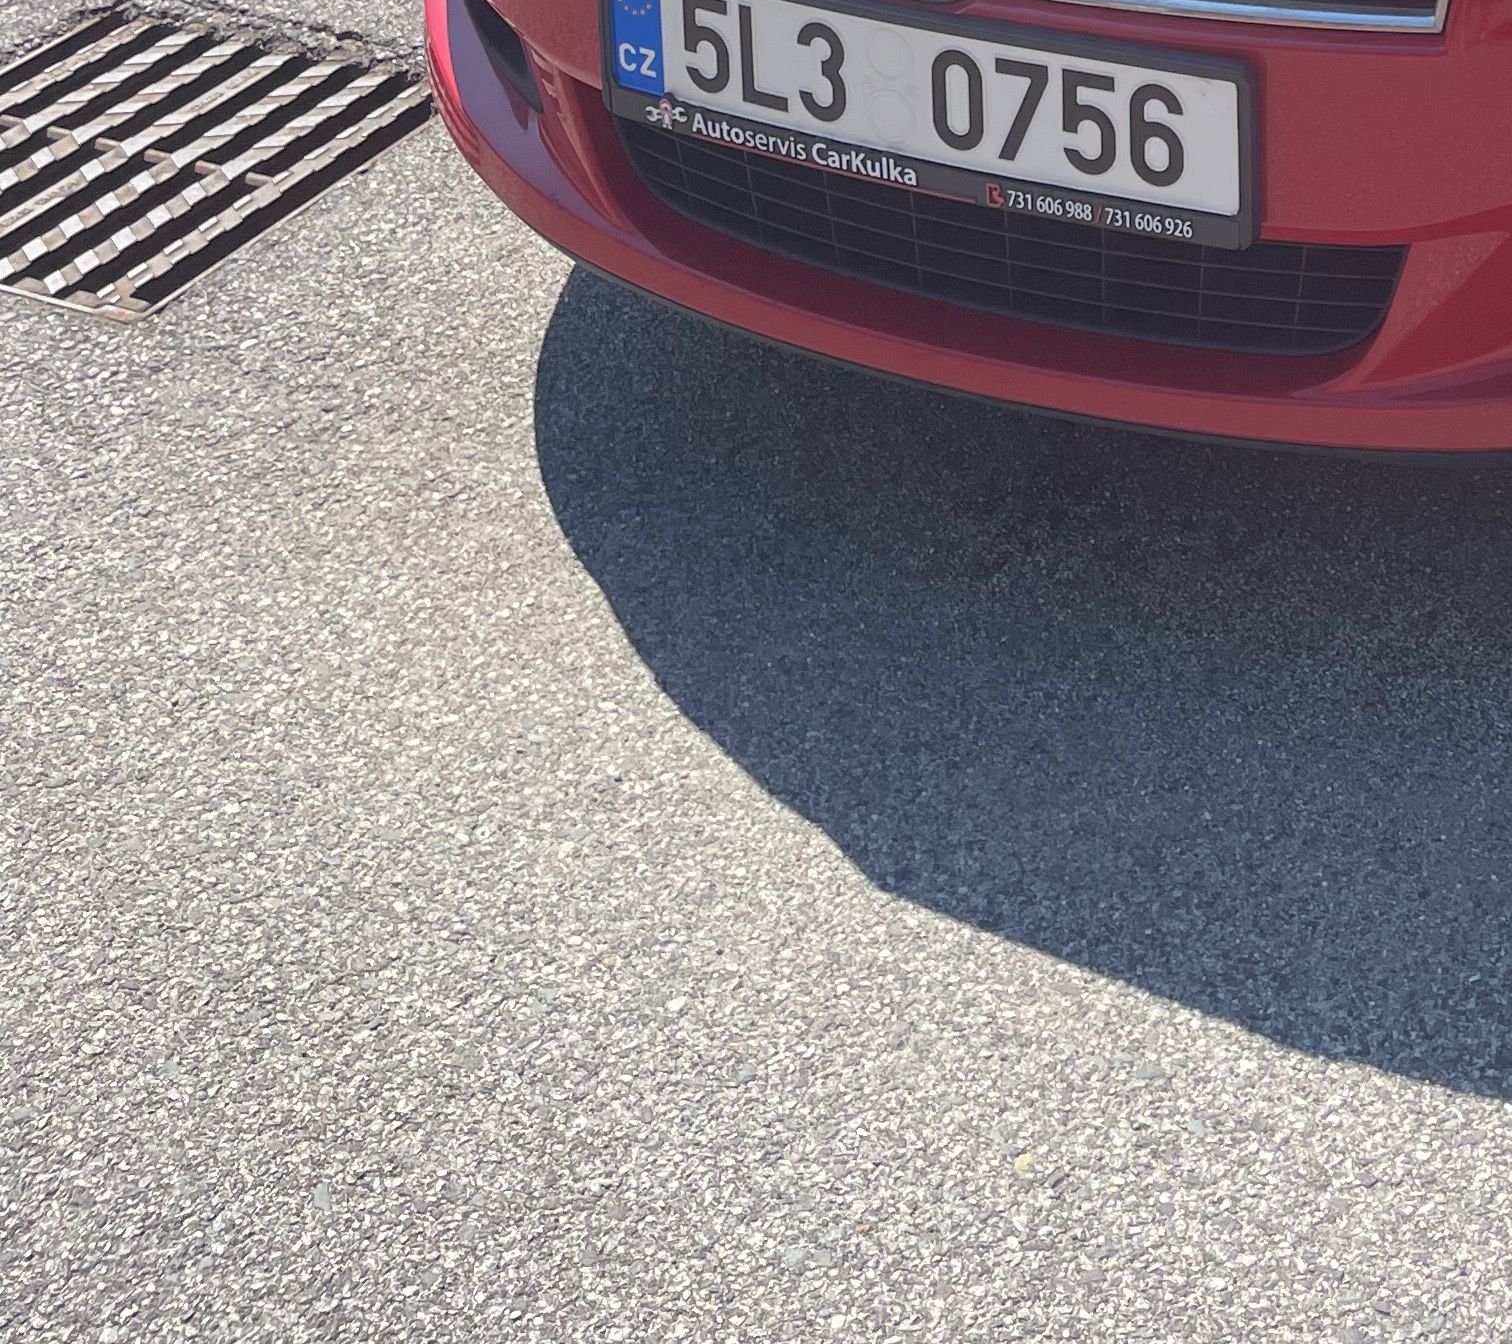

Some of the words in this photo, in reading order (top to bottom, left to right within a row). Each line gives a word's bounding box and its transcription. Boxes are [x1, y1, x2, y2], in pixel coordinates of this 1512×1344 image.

[618, 42, 657, 78] CZ
[691, 112, 807, 161] Autoservis
[811, 142, 918, 187] CarKulka
[930, 49, 1185, 188] 0756
[1006, 189, 1032, 211] 731
[1036, 195, 1063, 216] 606
[1065, 200, 1093, 221] 988
[1104, 207, 1131, 228] 731
[1134, 213, 1163, 234] 606
[1164, 218, 1193, 239] 926
